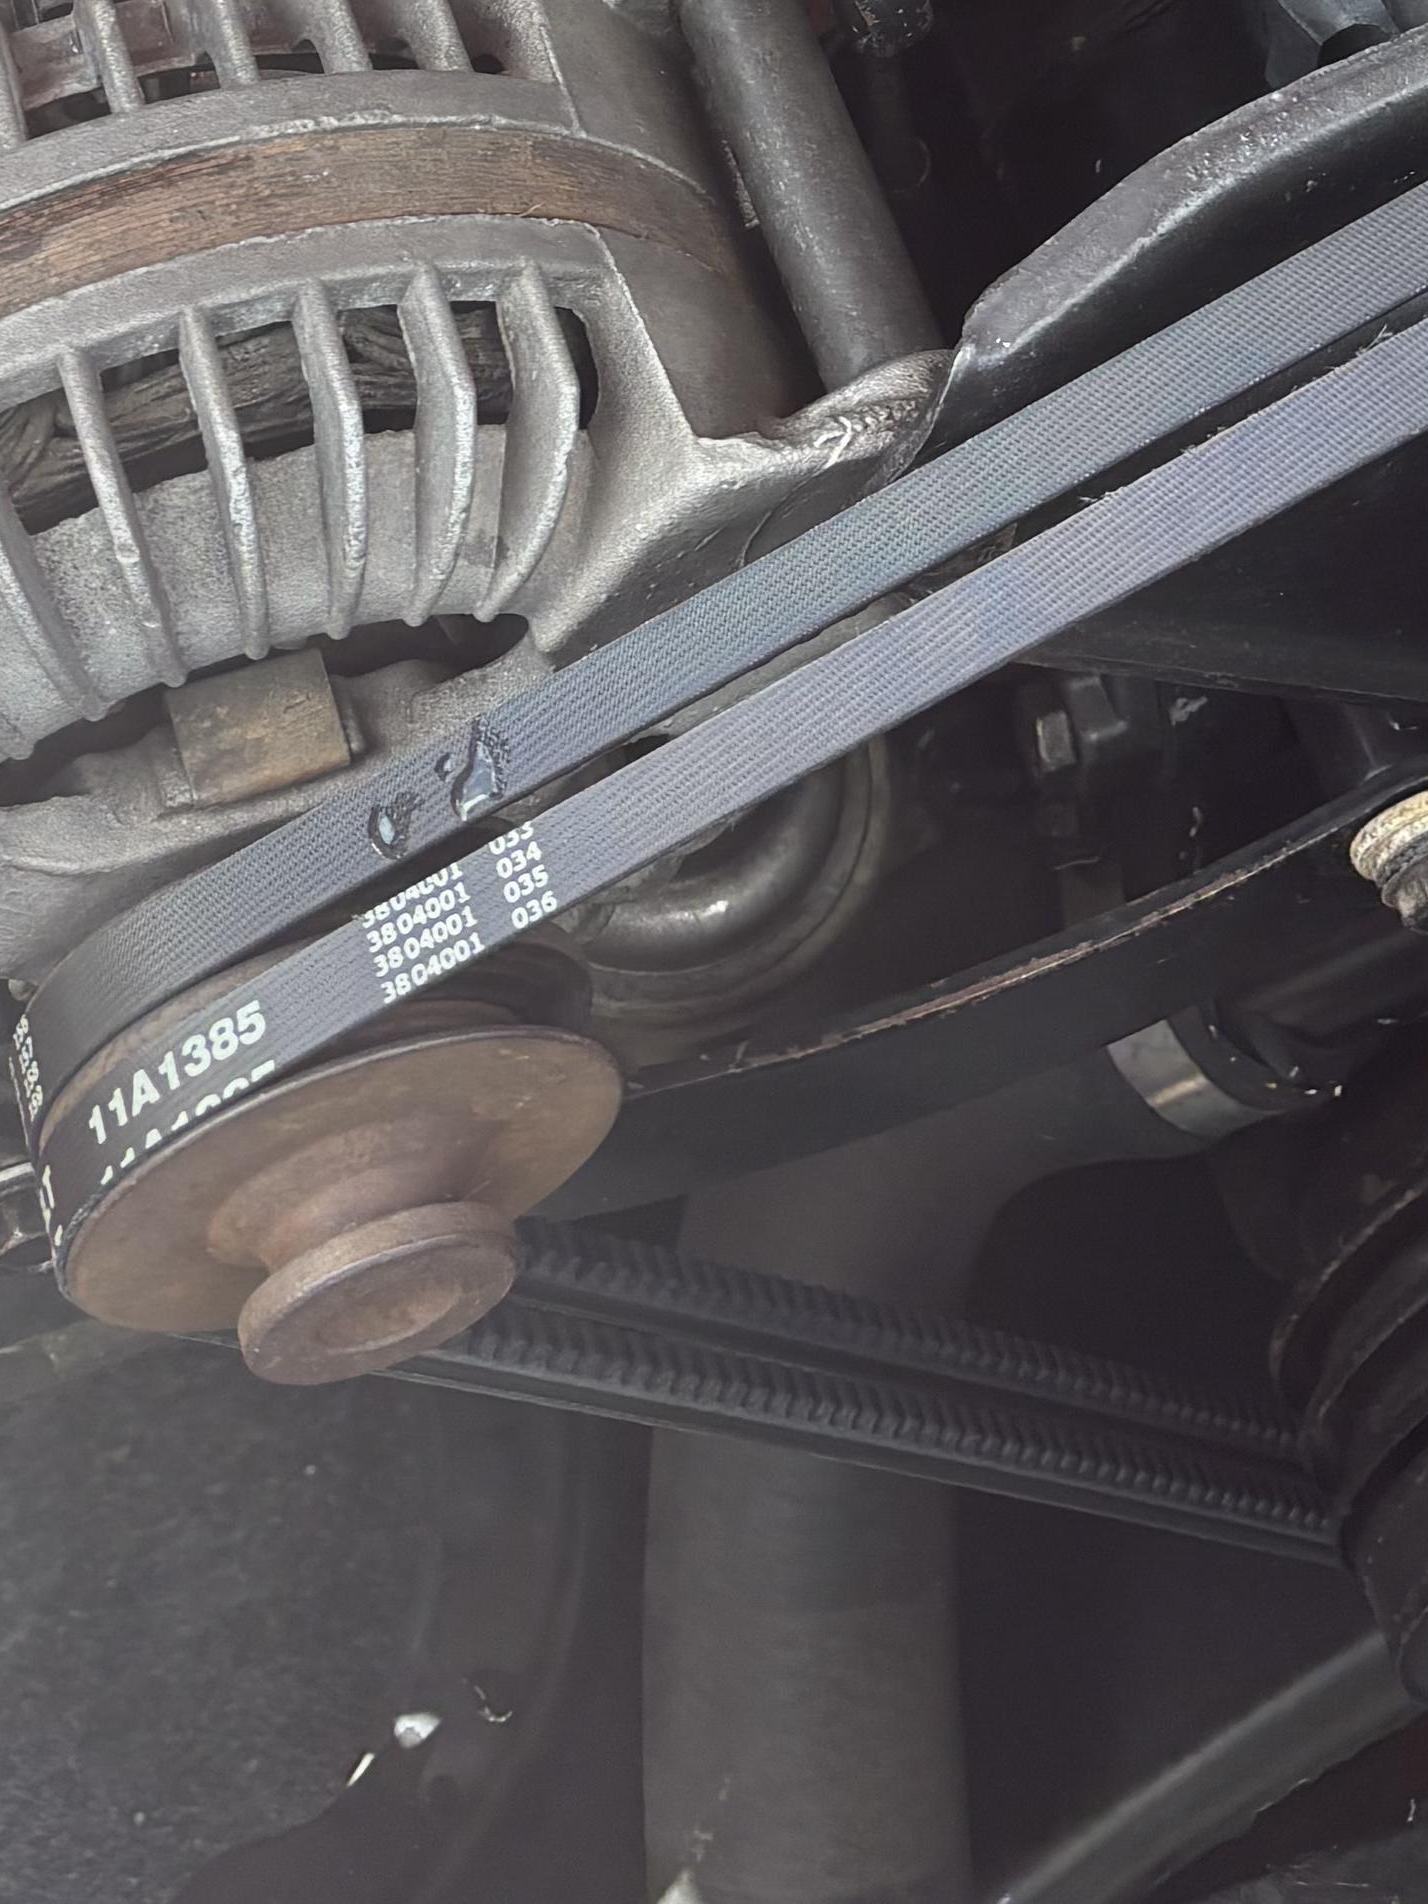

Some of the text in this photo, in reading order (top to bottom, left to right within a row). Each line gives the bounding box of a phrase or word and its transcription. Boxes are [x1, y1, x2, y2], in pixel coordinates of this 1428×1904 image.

[367, 841, 542, 953] 3804001 034
[373, 864, 549, 977] 3804001 035
[381, 890, 558, 1004] 3804001 036
[89, 1000, 266, 1144] 11A1385
